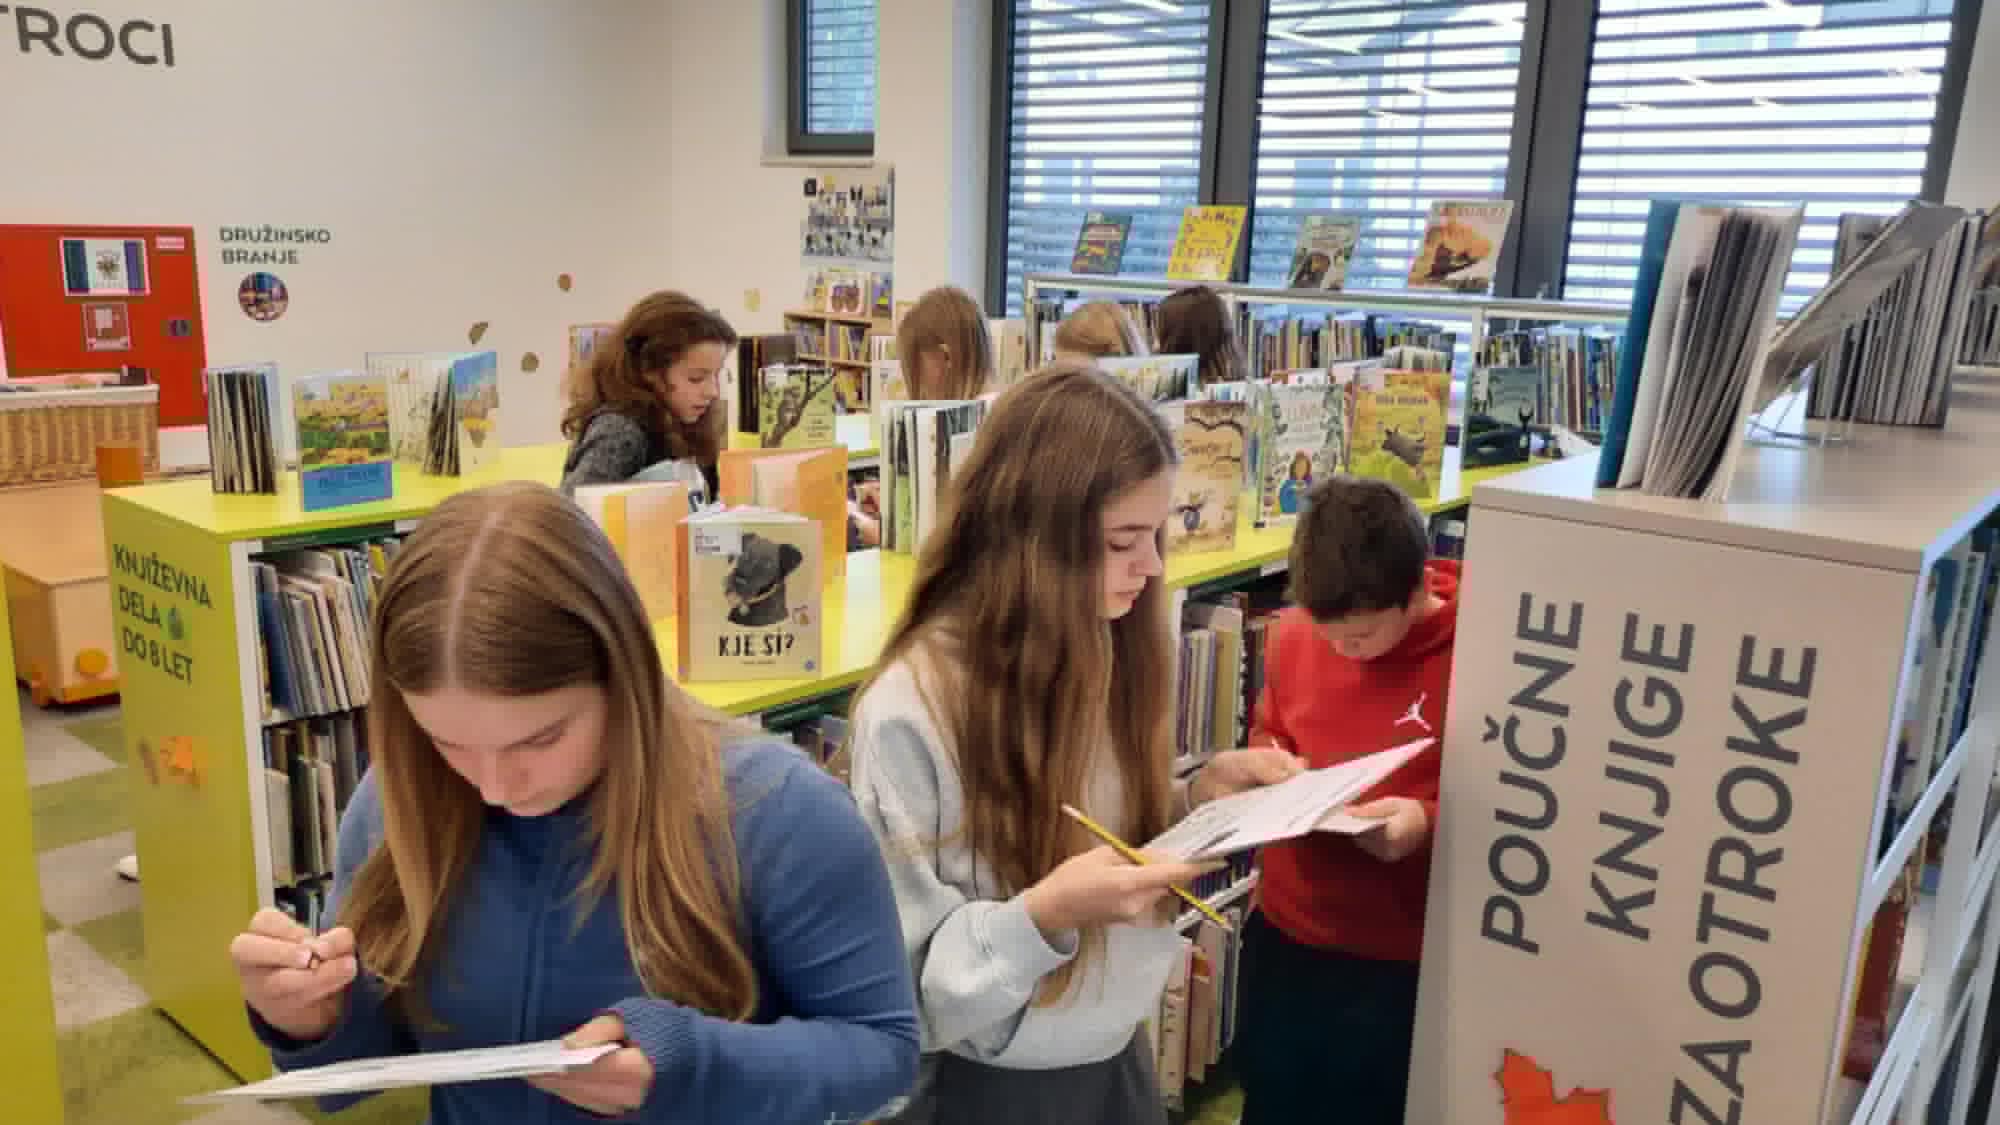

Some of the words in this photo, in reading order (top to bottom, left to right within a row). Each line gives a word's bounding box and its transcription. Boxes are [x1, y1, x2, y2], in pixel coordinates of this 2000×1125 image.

[0, 5, 175, 67] ROCI
[219, 225, 331, 244] DRUŽINSKO
[222, 248, 299, 264] BRANJE
[113, 543, 214, 608] KNJIŽEVNA
[118, 584, 162, 629] DELA
[122, 625, 146, 661] DO
[149, 639, 160, 668] 8
[162, 644, 193, 687] LET
[719, 634, 757, 657] KJE
[1481, 592, 1584, 956] POUČNE
[1586, 612, 1695, 941] KNJIGE
[1687, 634, 1817, 1019] OTROKE
[1668, 1039, 1752, 1125] ZA
